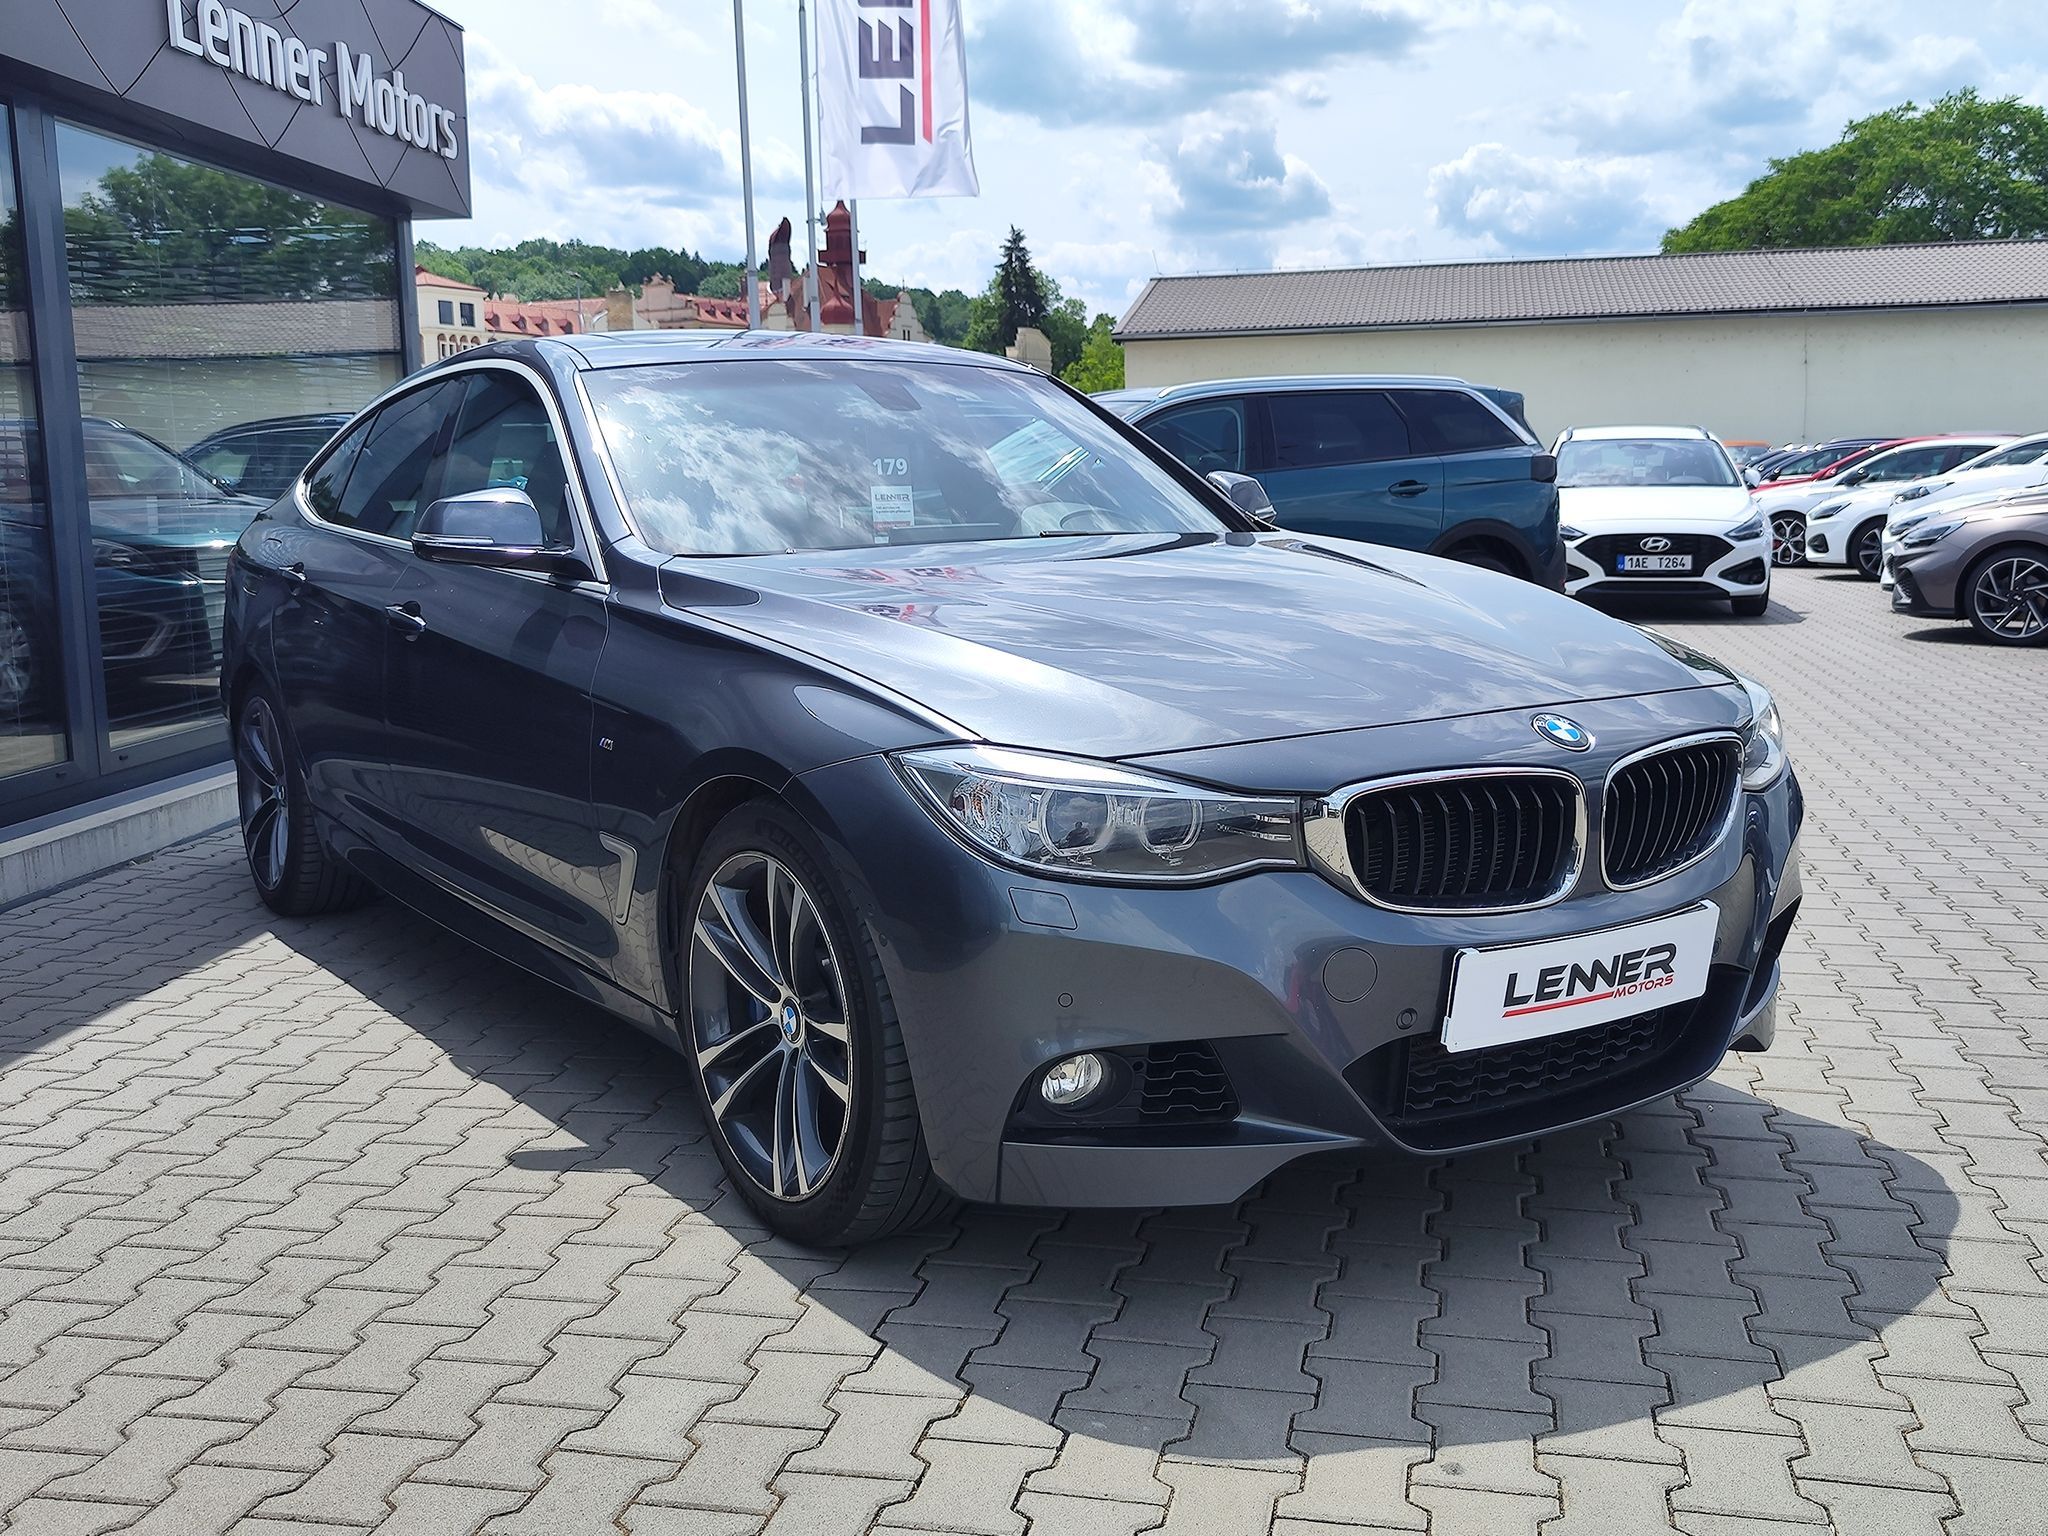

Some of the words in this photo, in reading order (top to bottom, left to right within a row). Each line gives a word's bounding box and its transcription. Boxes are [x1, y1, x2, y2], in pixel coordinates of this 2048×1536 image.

[167, 0, 328, 106] Lenner
[334, 41, 458, 160] Motors
[872, 457, 908, 475] 179
[1627, 556, 1649, 569] 1AE
[1656, 556, 1686, 569] T264
[1502, 943, 1677, 1008] LENNER
[1613, 973, 1675, 999] MOTORS
